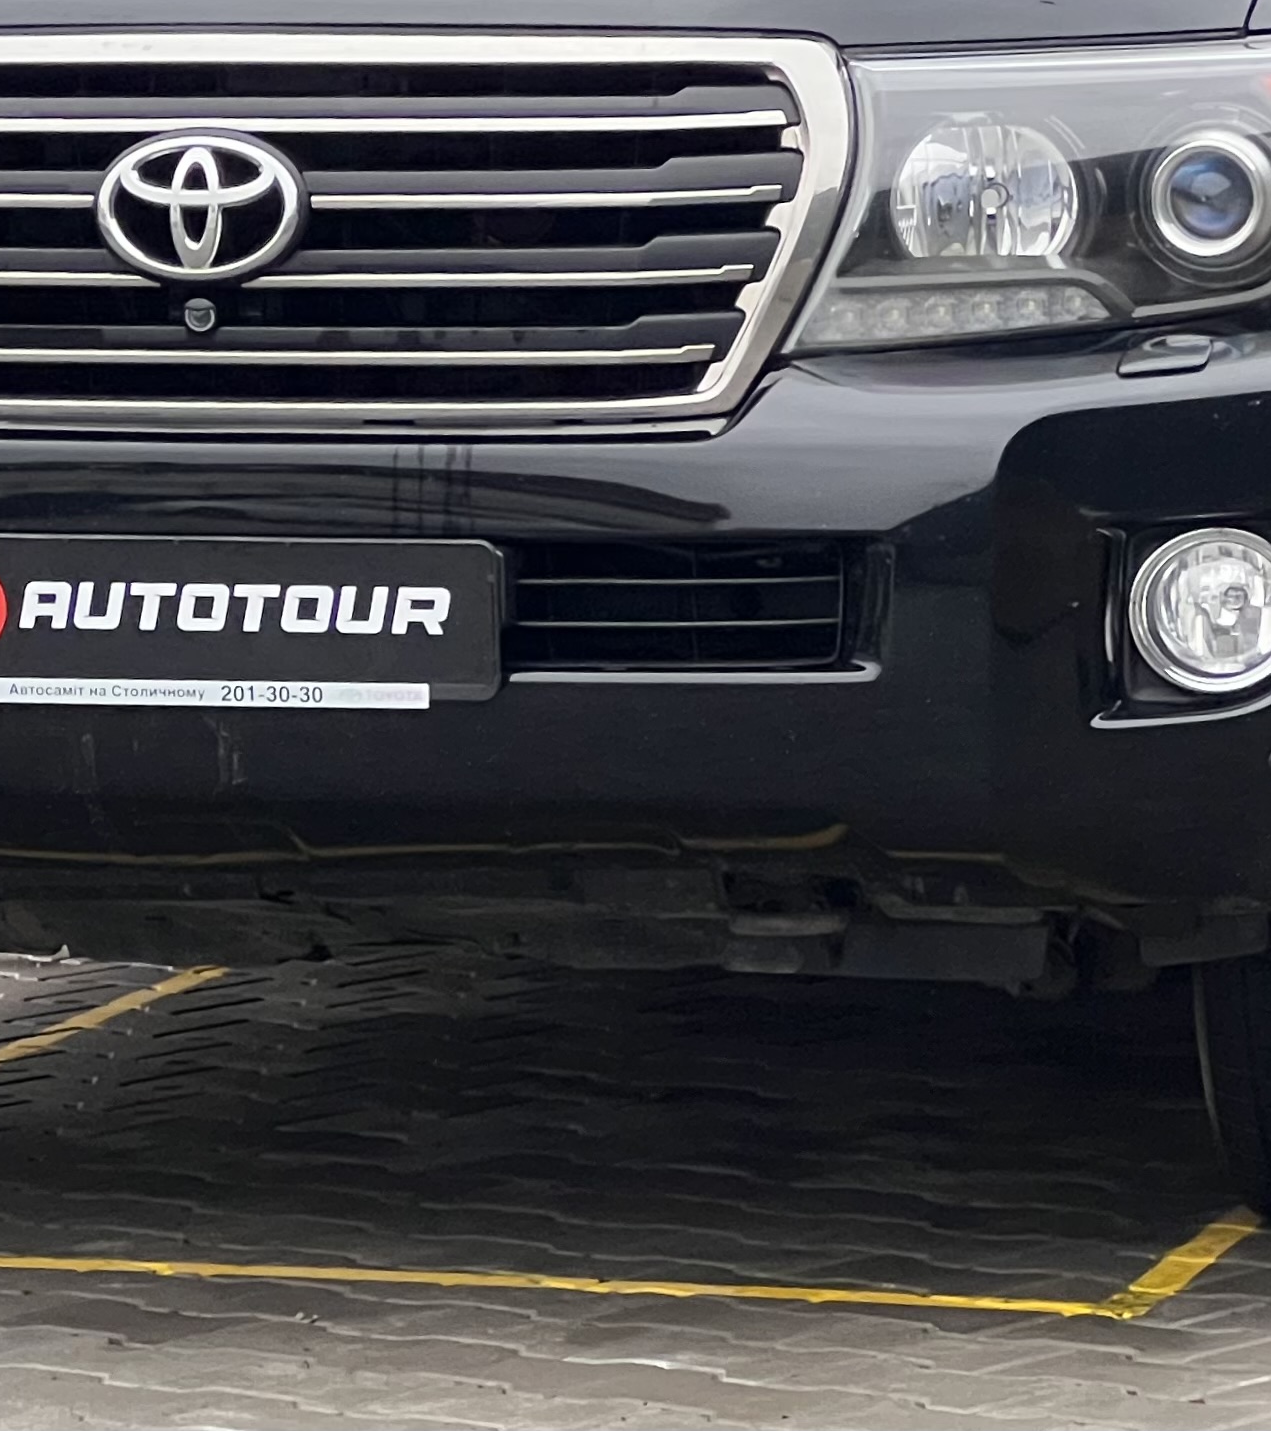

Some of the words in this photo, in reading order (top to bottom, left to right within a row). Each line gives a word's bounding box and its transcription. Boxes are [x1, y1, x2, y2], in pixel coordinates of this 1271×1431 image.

[18, 581, 451, 635] AUTOTOUR
[89, 686, 107, 697] на
[111, 685, 206, 701] Столичному
[221, 685, 323, 703] 201-30-30
